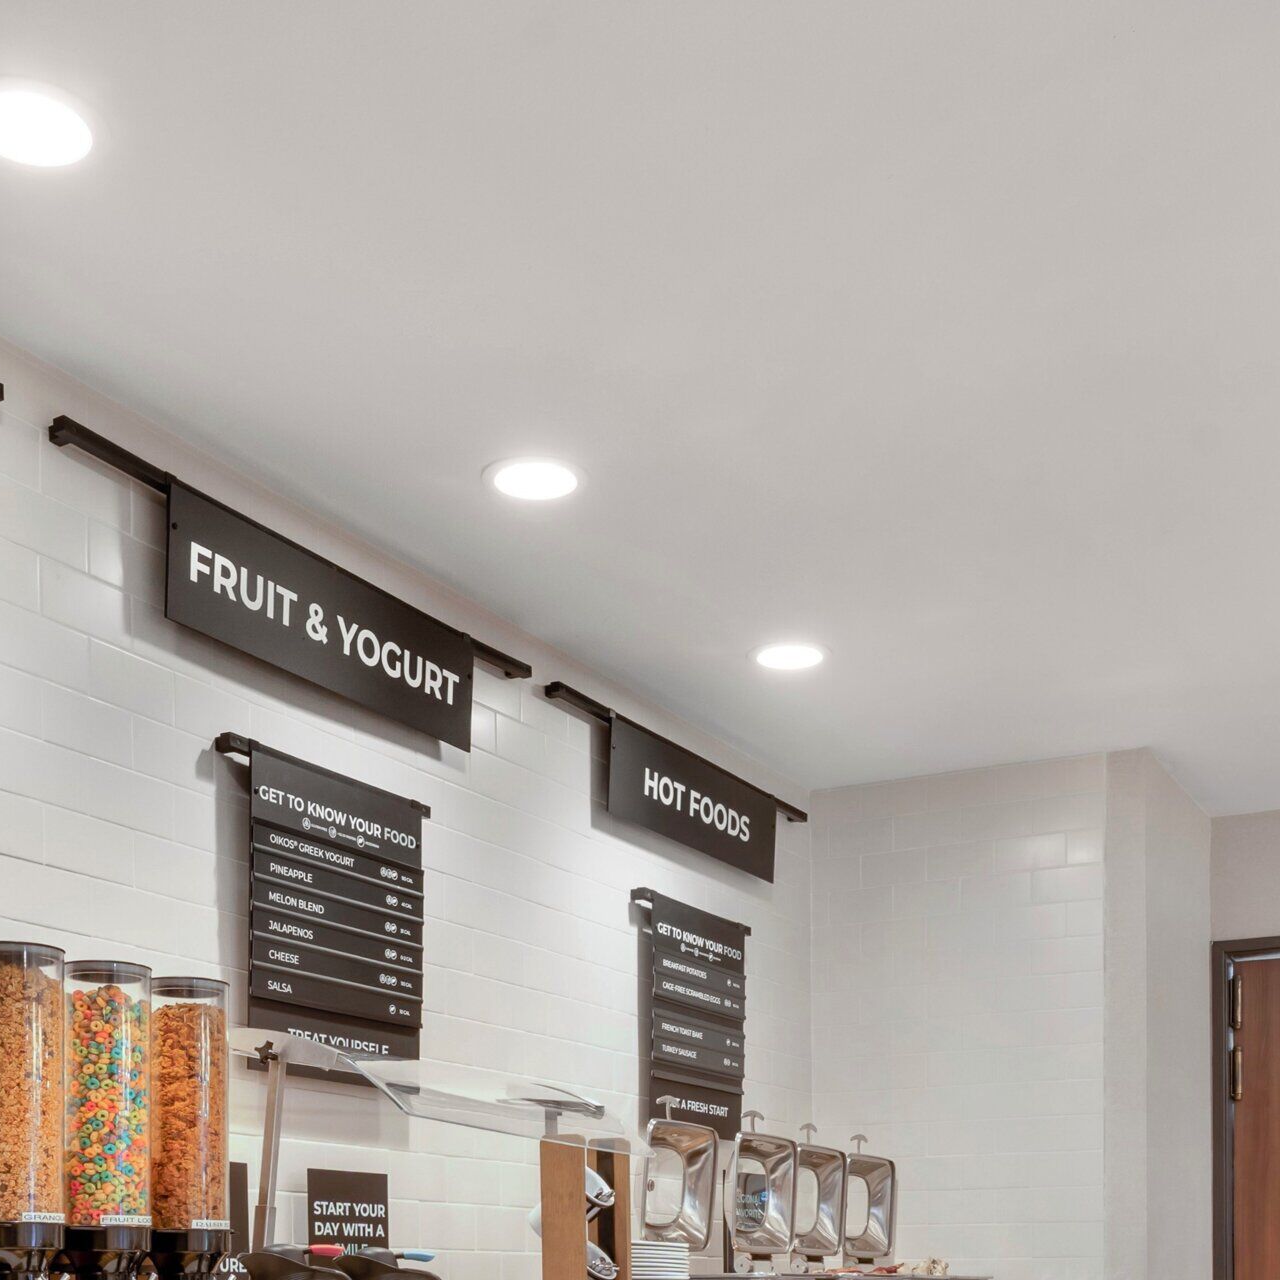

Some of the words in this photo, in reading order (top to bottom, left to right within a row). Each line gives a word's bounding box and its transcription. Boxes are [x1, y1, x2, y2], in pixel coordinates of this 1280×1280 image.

[189, 540, 298, 629] FRUIT
[305, 602, 329, 645] &
[336, 614, 460, 706] YOGURT
[644, 767, 686, 811] HOT
[689, 789, 750, 842] FOODS
[259, 785, 285, 806] GET
[286, 794, 305, 812] TO
[307, 801, 347, 826] KNOW
[349, 814, 382, 839] YOUR
[384, 827, 417, 849] FOOD
[298, 842, 325, 859] GREEK
[324, 851, 355, 868] YOGURT
[270, 862, 313, 883] PINEAPPLE
[268, 891, 297, 908] MELON
[298, 899, 325, 915] BLEND
[268, 920, 314, 940] JALAPENOS
[657, 922, 672, 937] GET
[671, 927, 682, 940] TO
[682, 931, 705, 948] KNOW
[704, 939, 724, 954] YOUR
[723, 946, 742, 960] FOOD
[268, 949, 300, 965] CHEESE
[662, 958, 687, 973] BREAKFAST
[686, 966, 707, 979] POTATOES
[267, 980, 293, 994] SALSA
[662, 981, 686, 995] CAGE-FREE
[661, 1022, 679, 1034] FRENCH
[678, 1027, 692, 1037] TOAST
[662, 1044, 679, 1054] TURKEY
[678, 1047, 697, 1059] SAUSAGE
[680, 1099, 687, 1110] A
[687, 1100, 708, 1113] FRESH
[708, 1104, 729, 1117] START
[313, 1200, 351, 1216] START
[352, 1203, 386, 1218] YOUR
[314, 1221, 340, 1236] DAY
[342, 1223, 373, 1237] WITH
[375, 1224, 385, 1238] A
